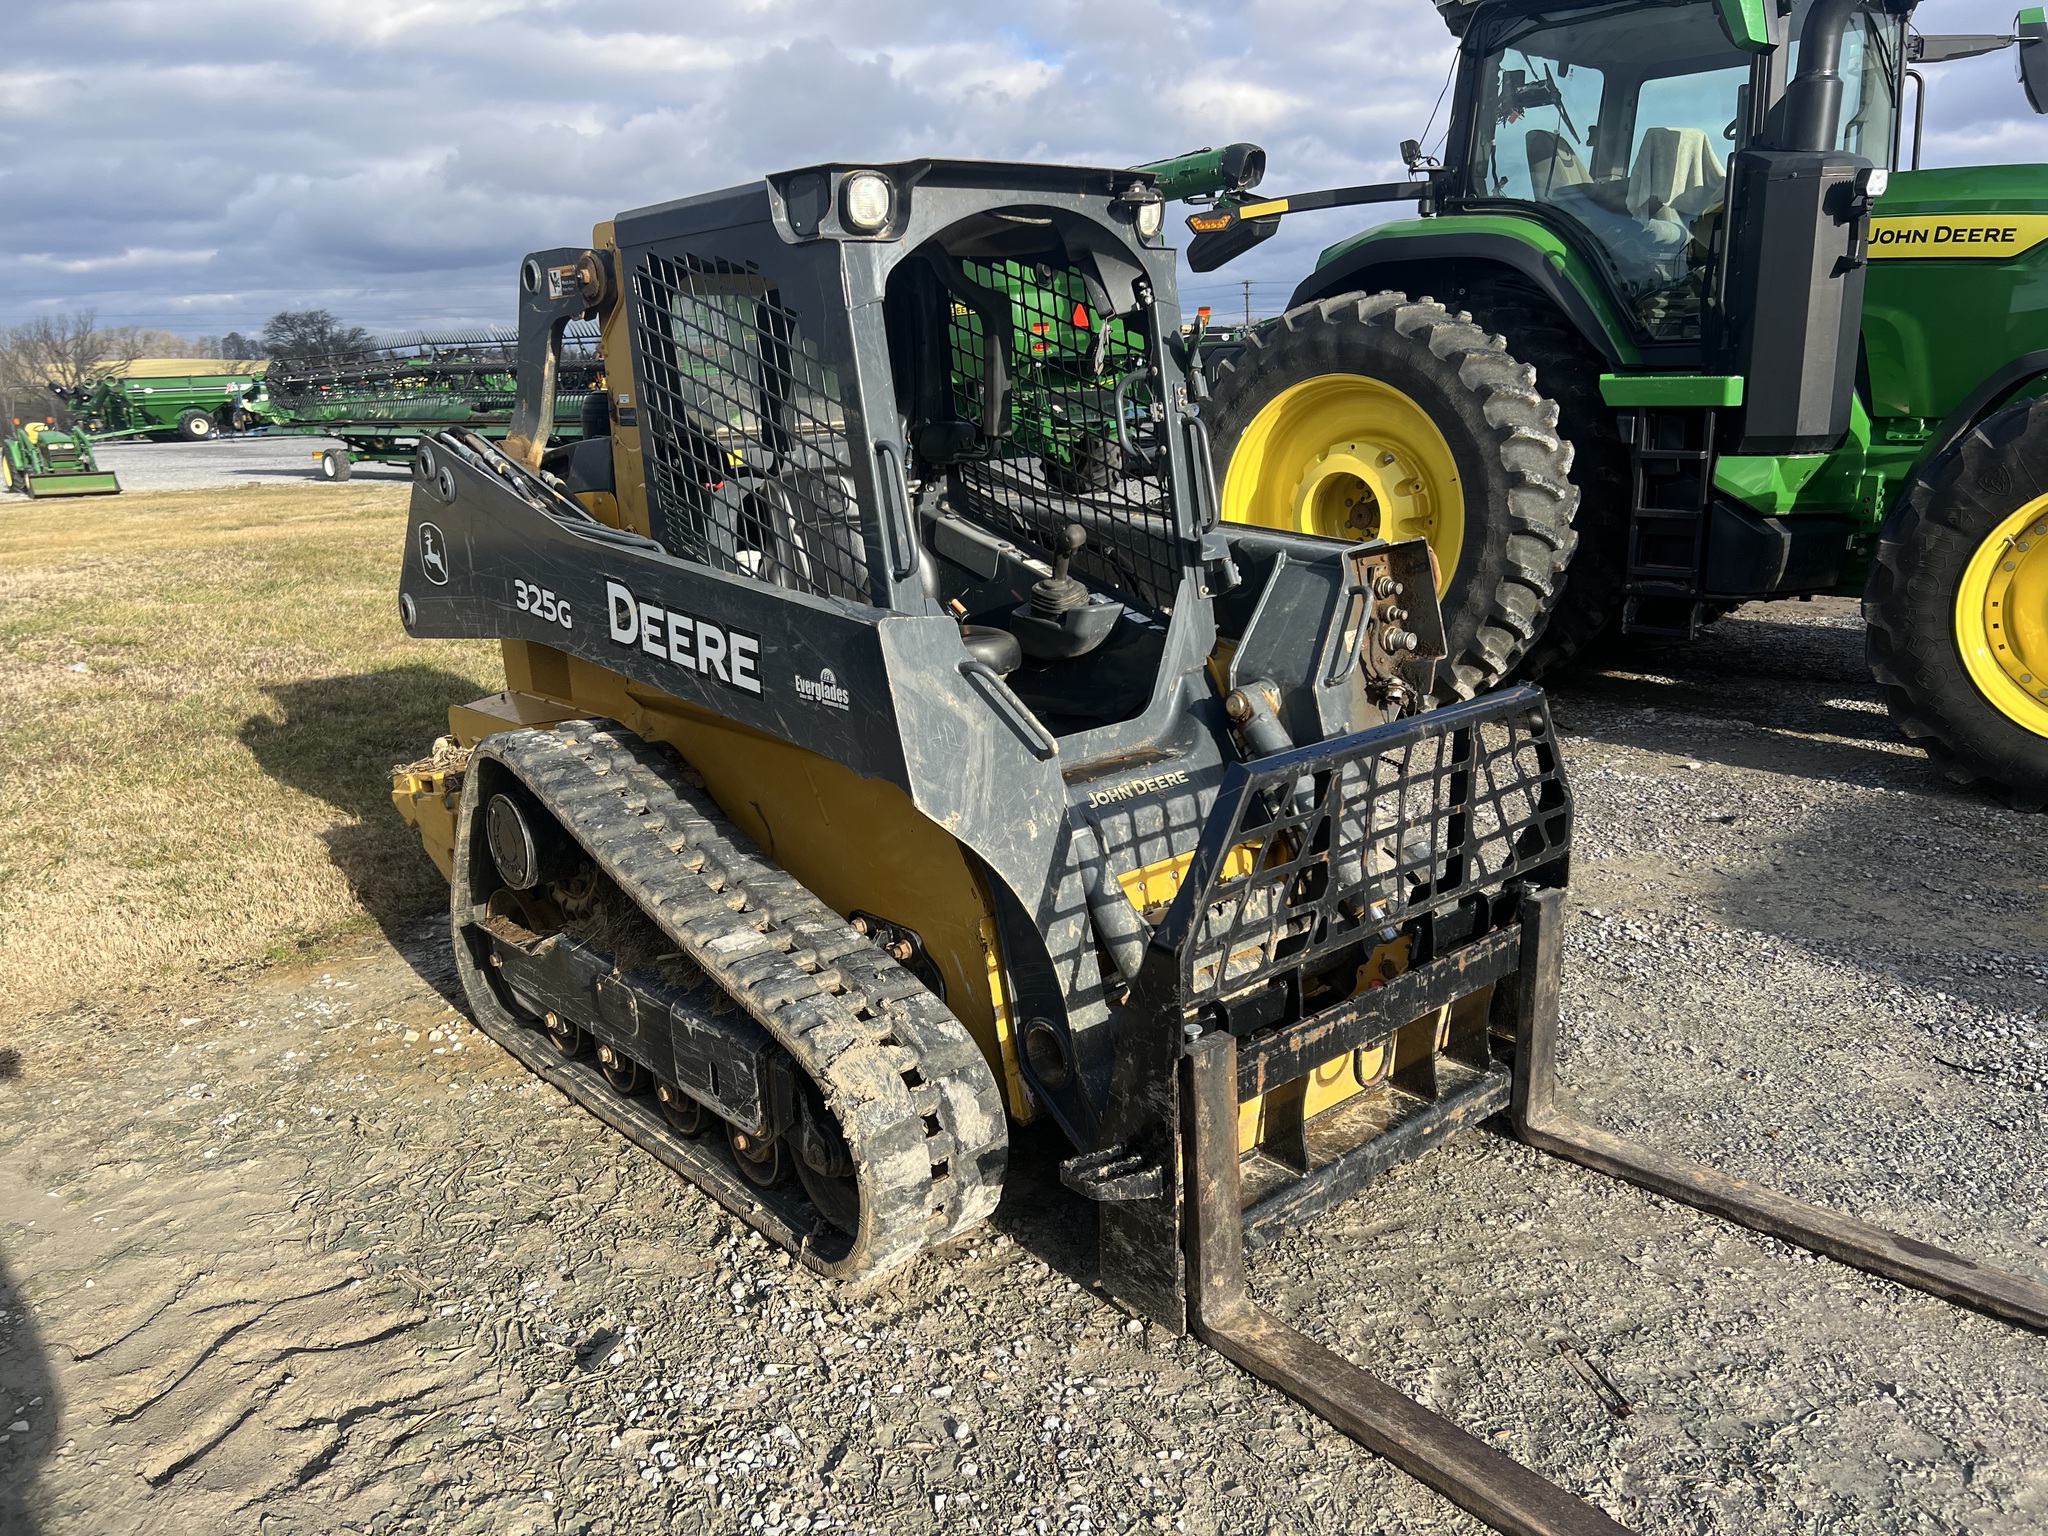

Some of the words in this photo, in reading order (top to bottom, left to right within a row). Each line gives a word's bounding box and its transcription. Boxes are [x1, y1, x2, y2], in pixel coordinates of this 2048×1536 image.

[1868, 227, 1929, 245] JOHN
[1933, 225, 2017, 243] DEERE
[514, 578, 573, 629] 325G
[606, 580, 761, 694] DEERE
[794, 674, 849, 705] Everglades
[1088, 784, 1134, 809] JOHN
[1130, 769, 1190, 796] DEERE
